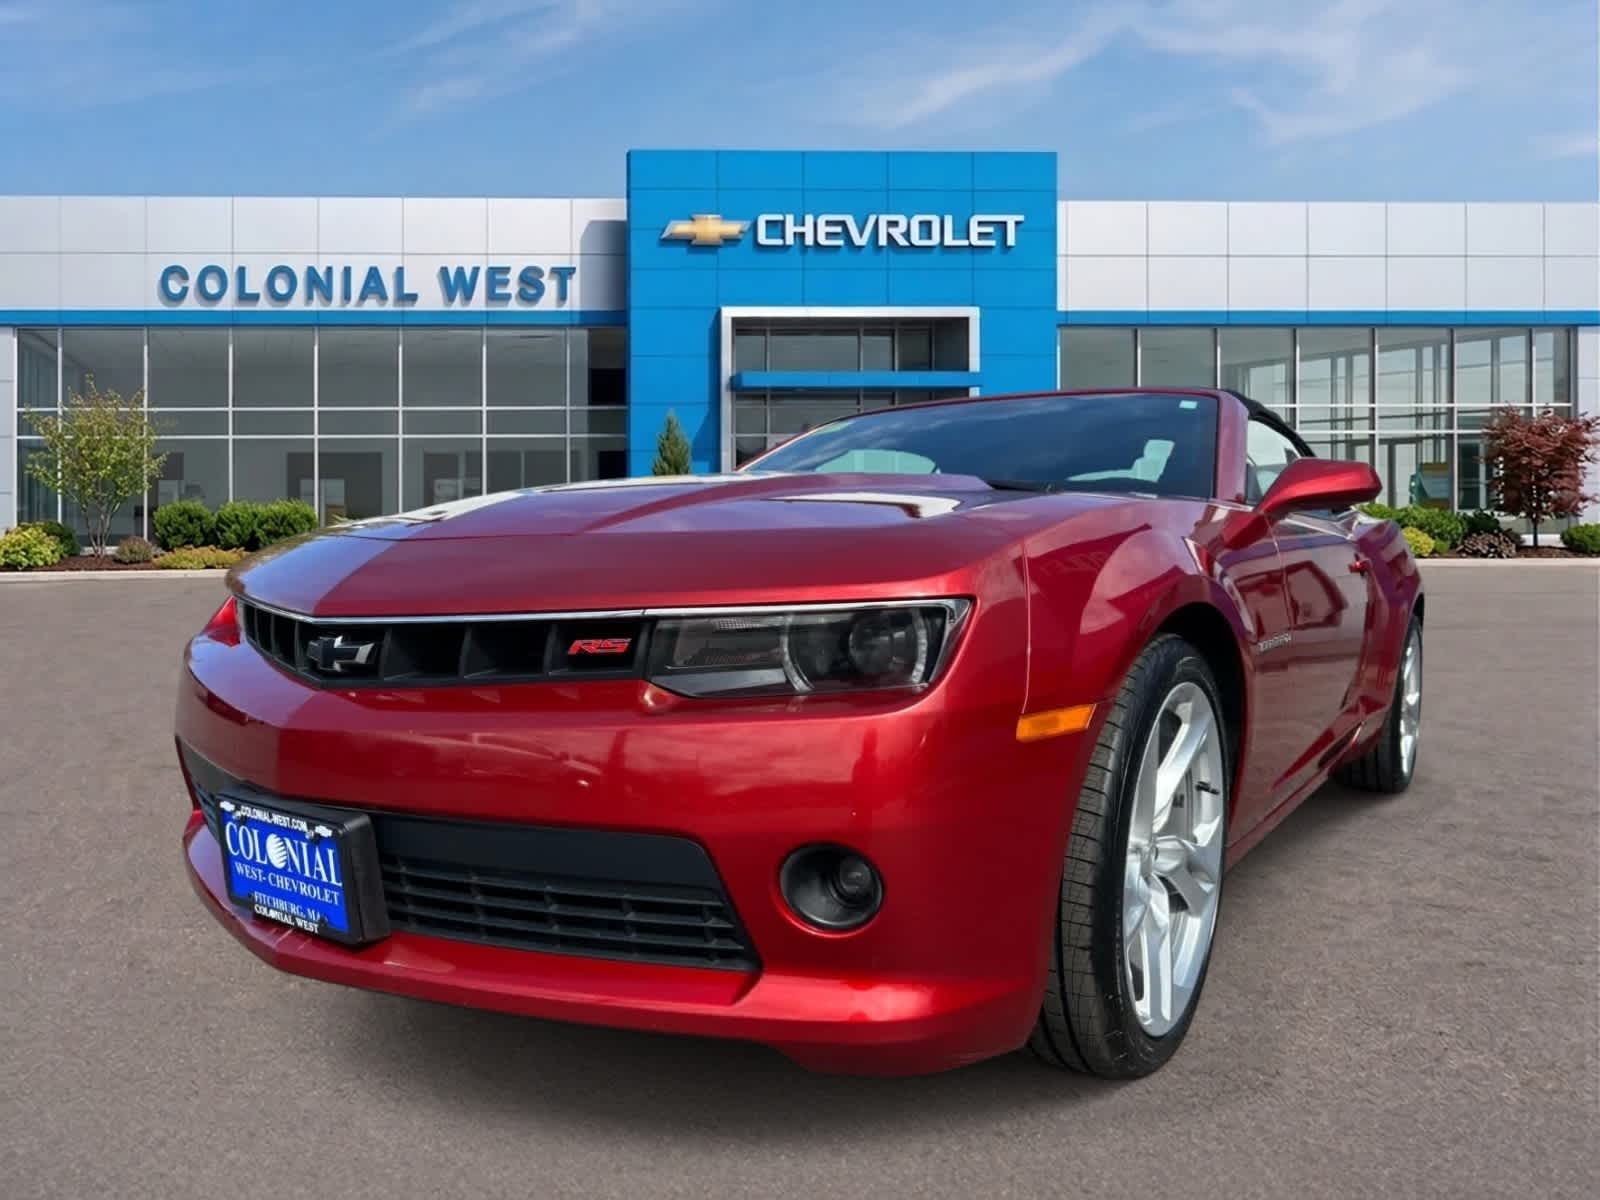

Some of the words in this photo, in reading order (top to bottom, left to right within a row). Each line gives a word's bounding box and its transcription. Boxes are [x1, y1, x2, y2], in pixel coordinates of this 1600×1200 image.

[757, 214, 1025, 247] CHEVROLET
[160, 264, 418, 303] COLONIAL
[438, 265, 577, 303] WEST
[568, 637, 632, 654] RS
[225, 821, 342, 887] COLONIAL
[295, 917, 320, 934] WEST
